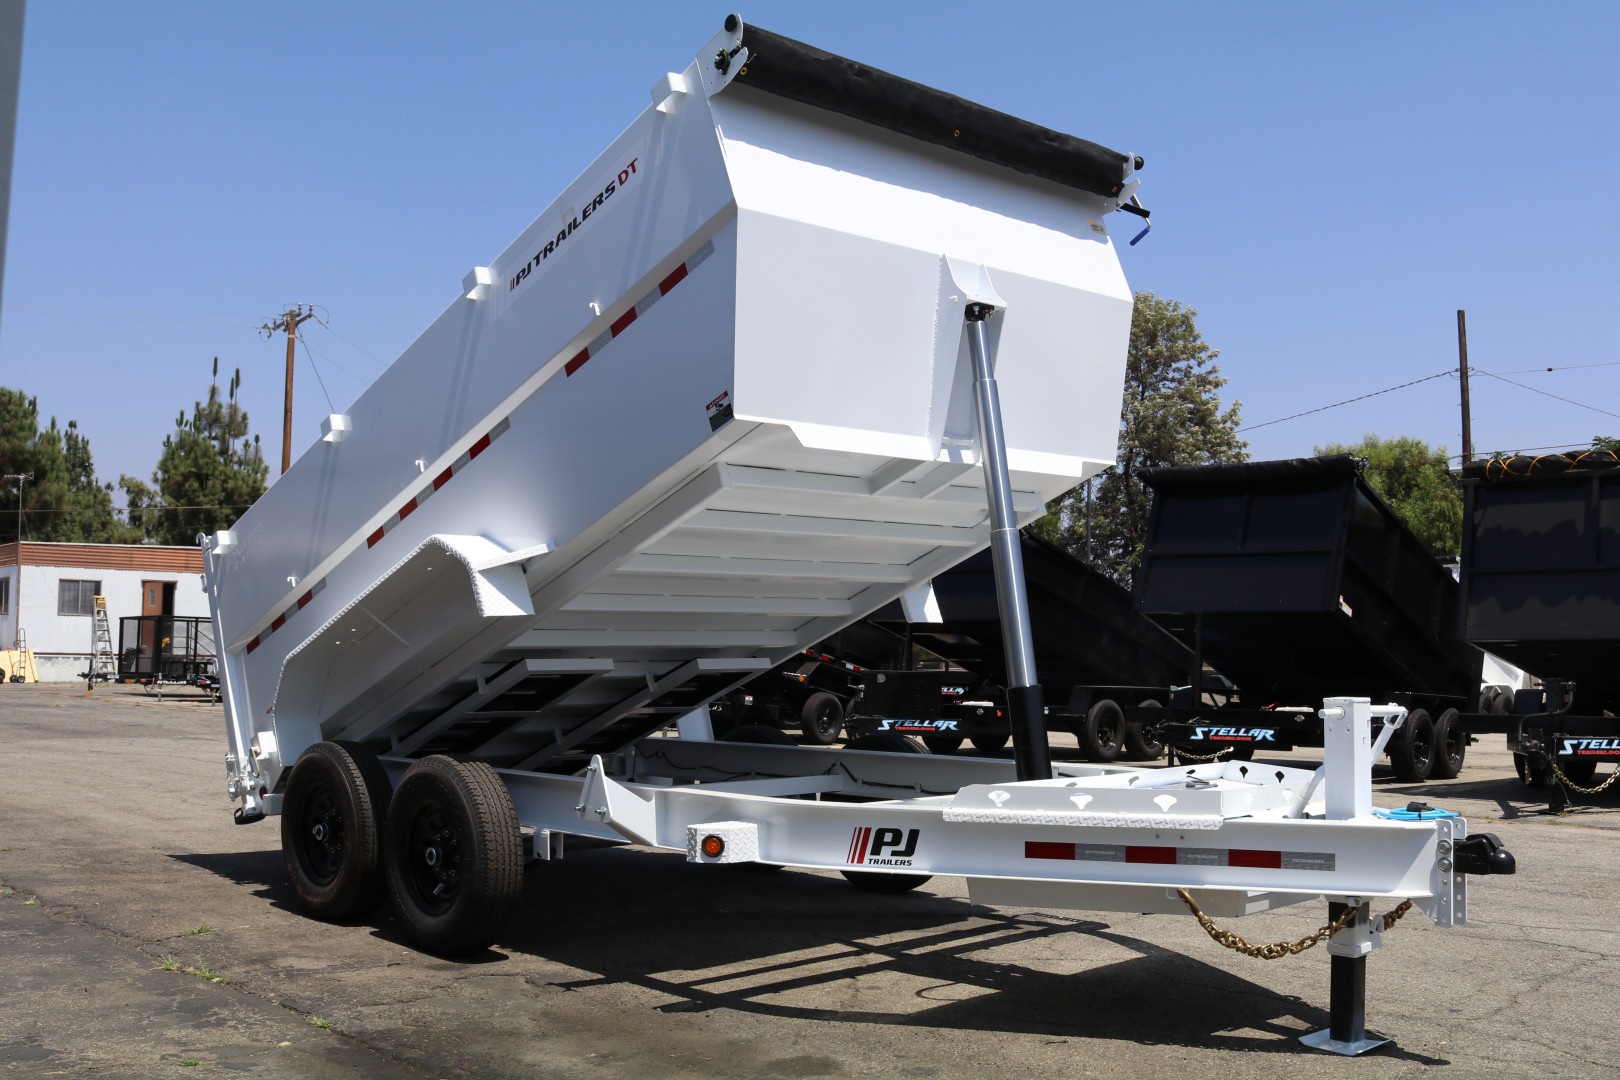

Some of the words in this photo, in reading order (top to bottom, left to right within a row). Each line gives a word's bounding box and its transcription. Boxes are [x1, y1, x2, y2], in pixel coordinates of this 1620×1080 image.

[515, 261, 532, 287] PJ
[533, 179, 616, 268] TRAILERS
[617, 157, 638, 187] DT
[877, 719, 960, 731] STELLAR
[1189, 726, 1276, 742] STELLAR
[870, 828, 920, 857] PJ
[868, 858, 913, 866] TRAILERS
